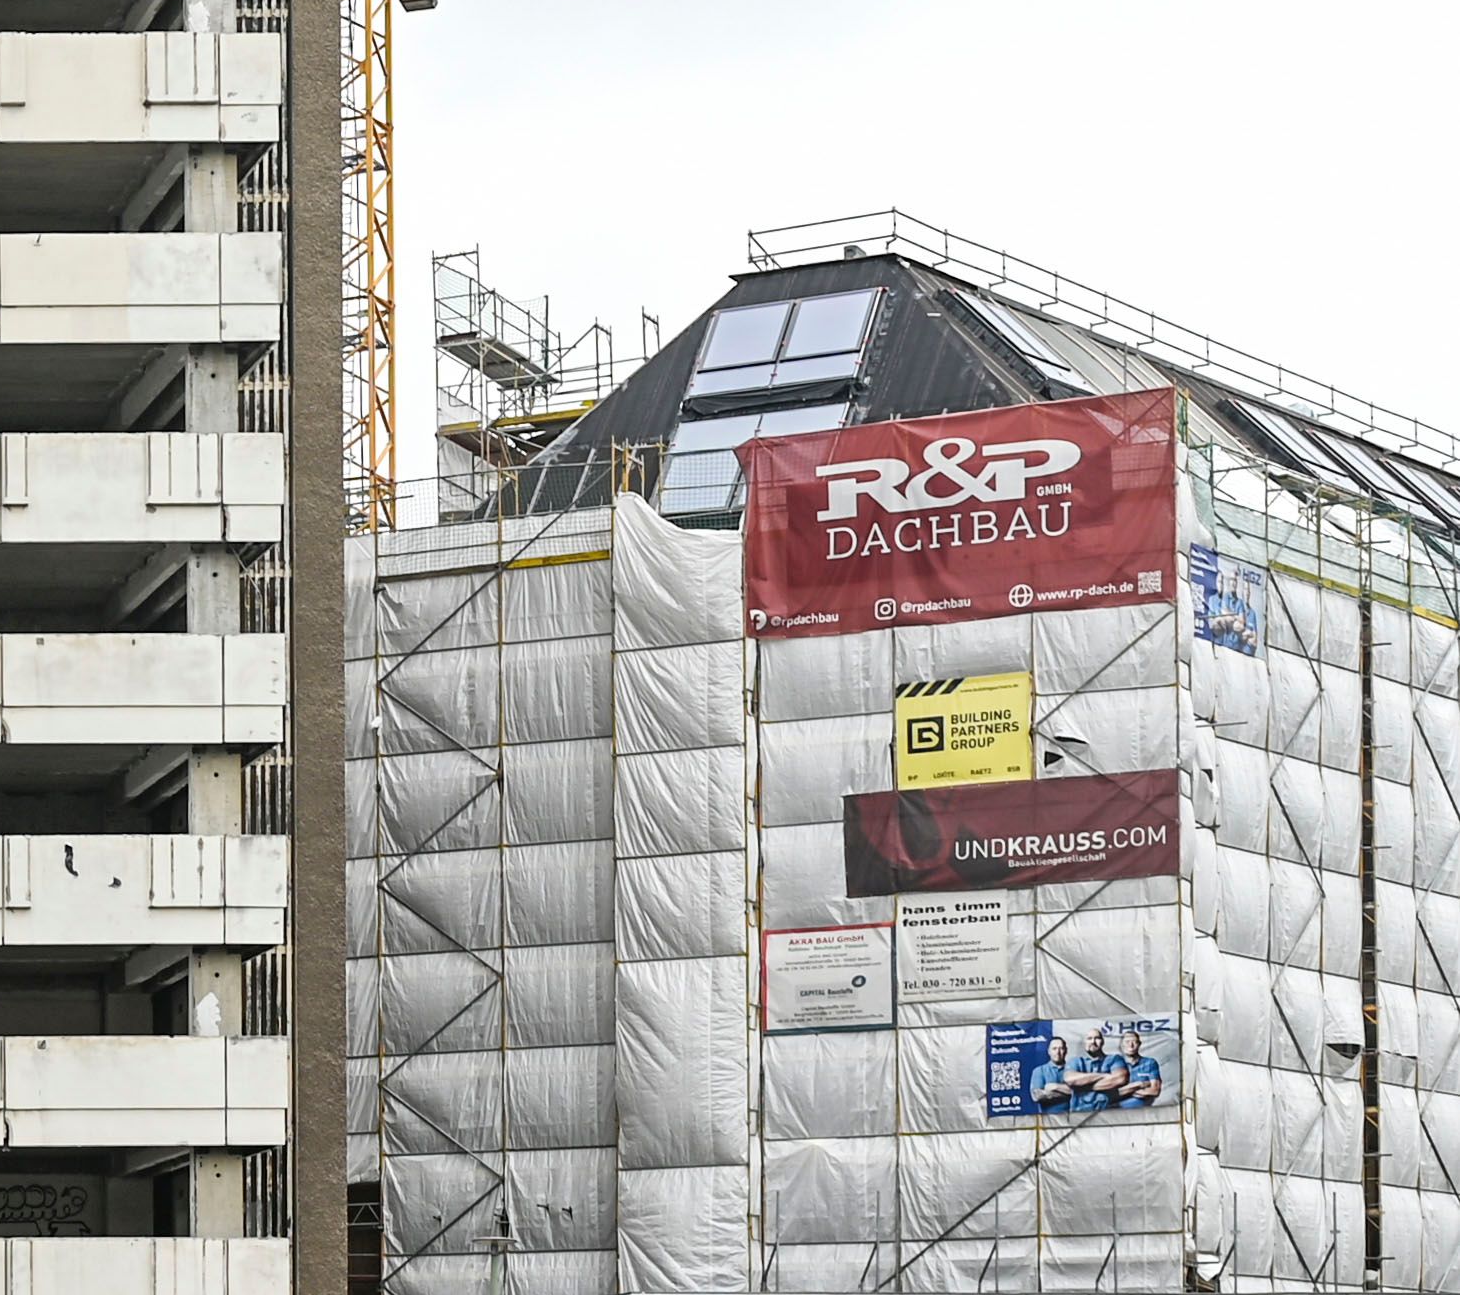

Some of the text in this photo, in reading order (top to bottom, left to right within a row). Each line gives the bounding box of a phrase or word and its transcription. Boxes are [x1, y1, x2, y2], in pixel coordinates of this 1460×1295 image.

[816, 437, 1081, 522] R&P
[1036, 483, 1072, 497] GMBH
[826, 502, 1072, 560] DACHBAU
[770, 581, 1134, 628] @rpdachbau @rpdachbau www.rp-dach.de
[951, 709, 1012, 725] BUILDING
[951, 721, 1019, 737] PARTNERS
[951, 737, 995, 750] GROUP
[955, 825, 1167, 860] UNDKRAUSS.COM
[902, 902, 1001, 915] hans timm
[902, 915, 1001, 927] fensterbau
[1119, 1019, 1170, 1034] HGZ
